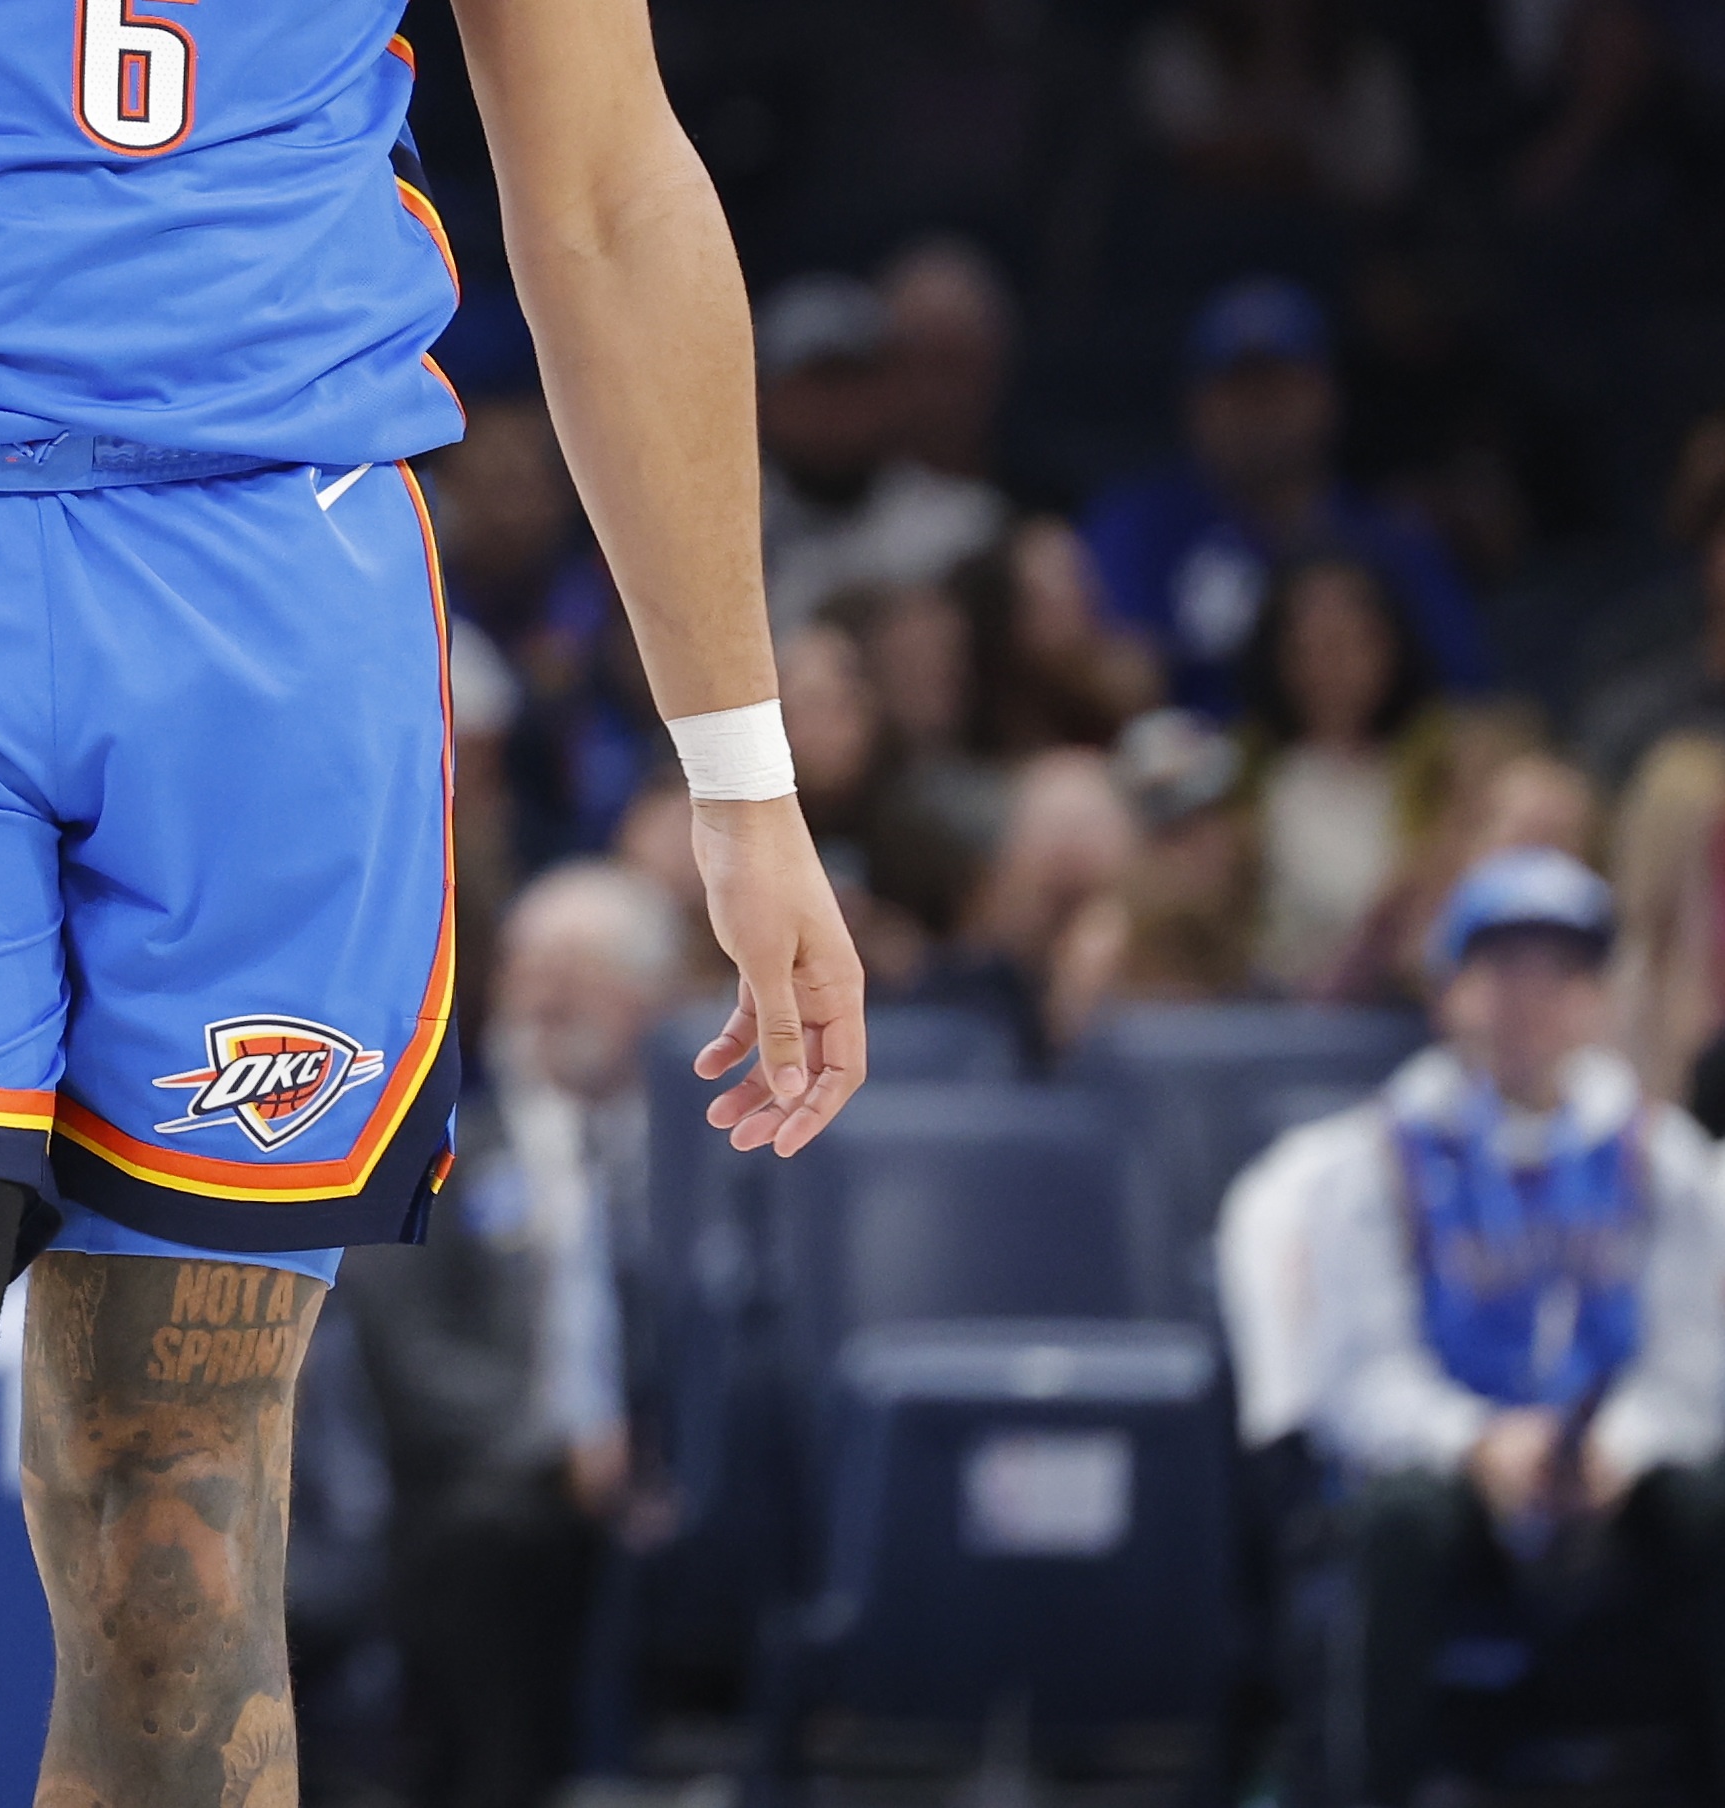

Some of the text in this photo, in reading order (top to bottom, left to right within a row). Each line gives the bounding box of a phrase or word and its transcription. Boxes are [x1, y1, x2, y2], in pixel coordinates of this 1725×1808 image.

[196, 1049, 328, 1112] OKC
[170, 1263, 296, 1325] NOT A
